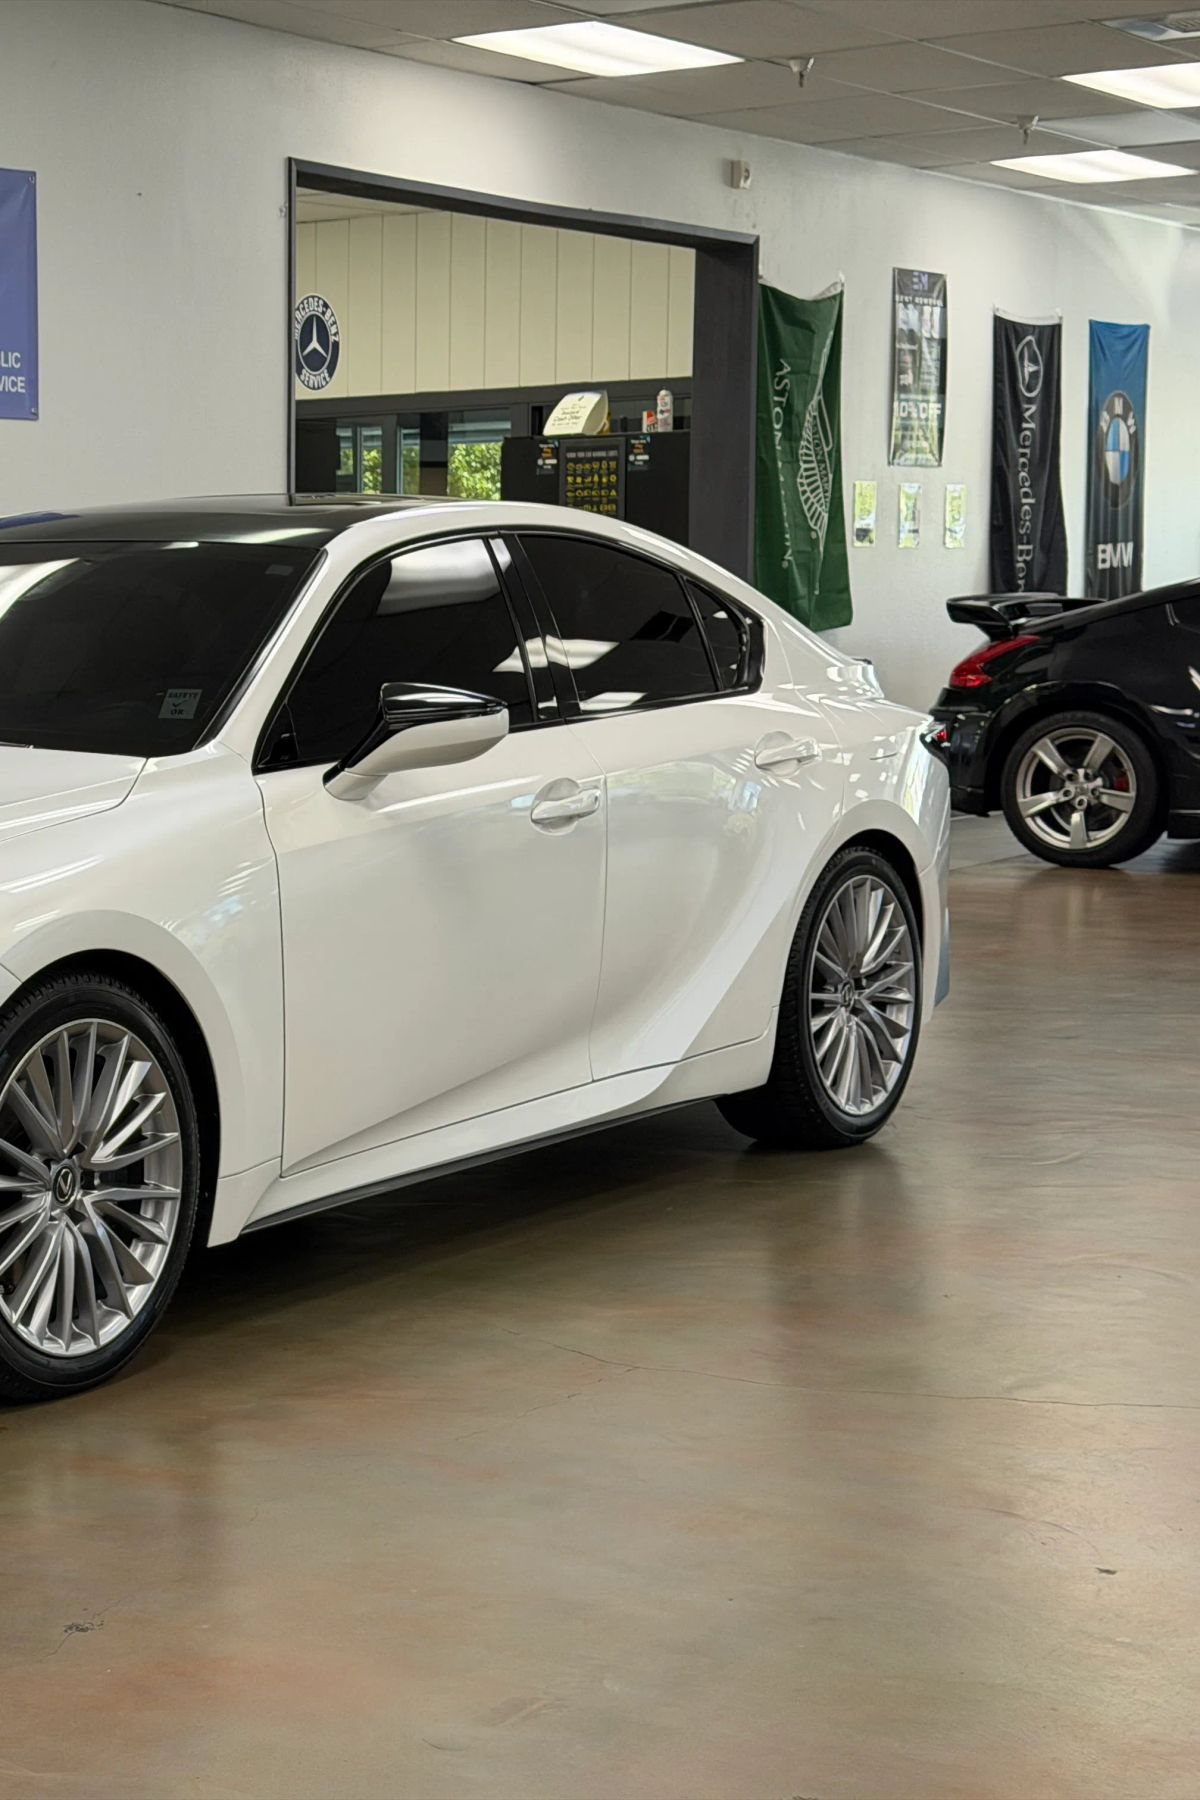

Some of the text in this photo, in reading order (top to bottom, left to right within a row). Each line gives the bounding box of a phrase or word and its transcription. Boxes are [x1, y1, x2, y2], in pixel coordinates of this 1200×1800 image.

[300, 368, 331, 389] SERVICE
[1015, 403, 1037, 593] Mercedes-Ben
[1097, 541, 1134, 570] BMW
